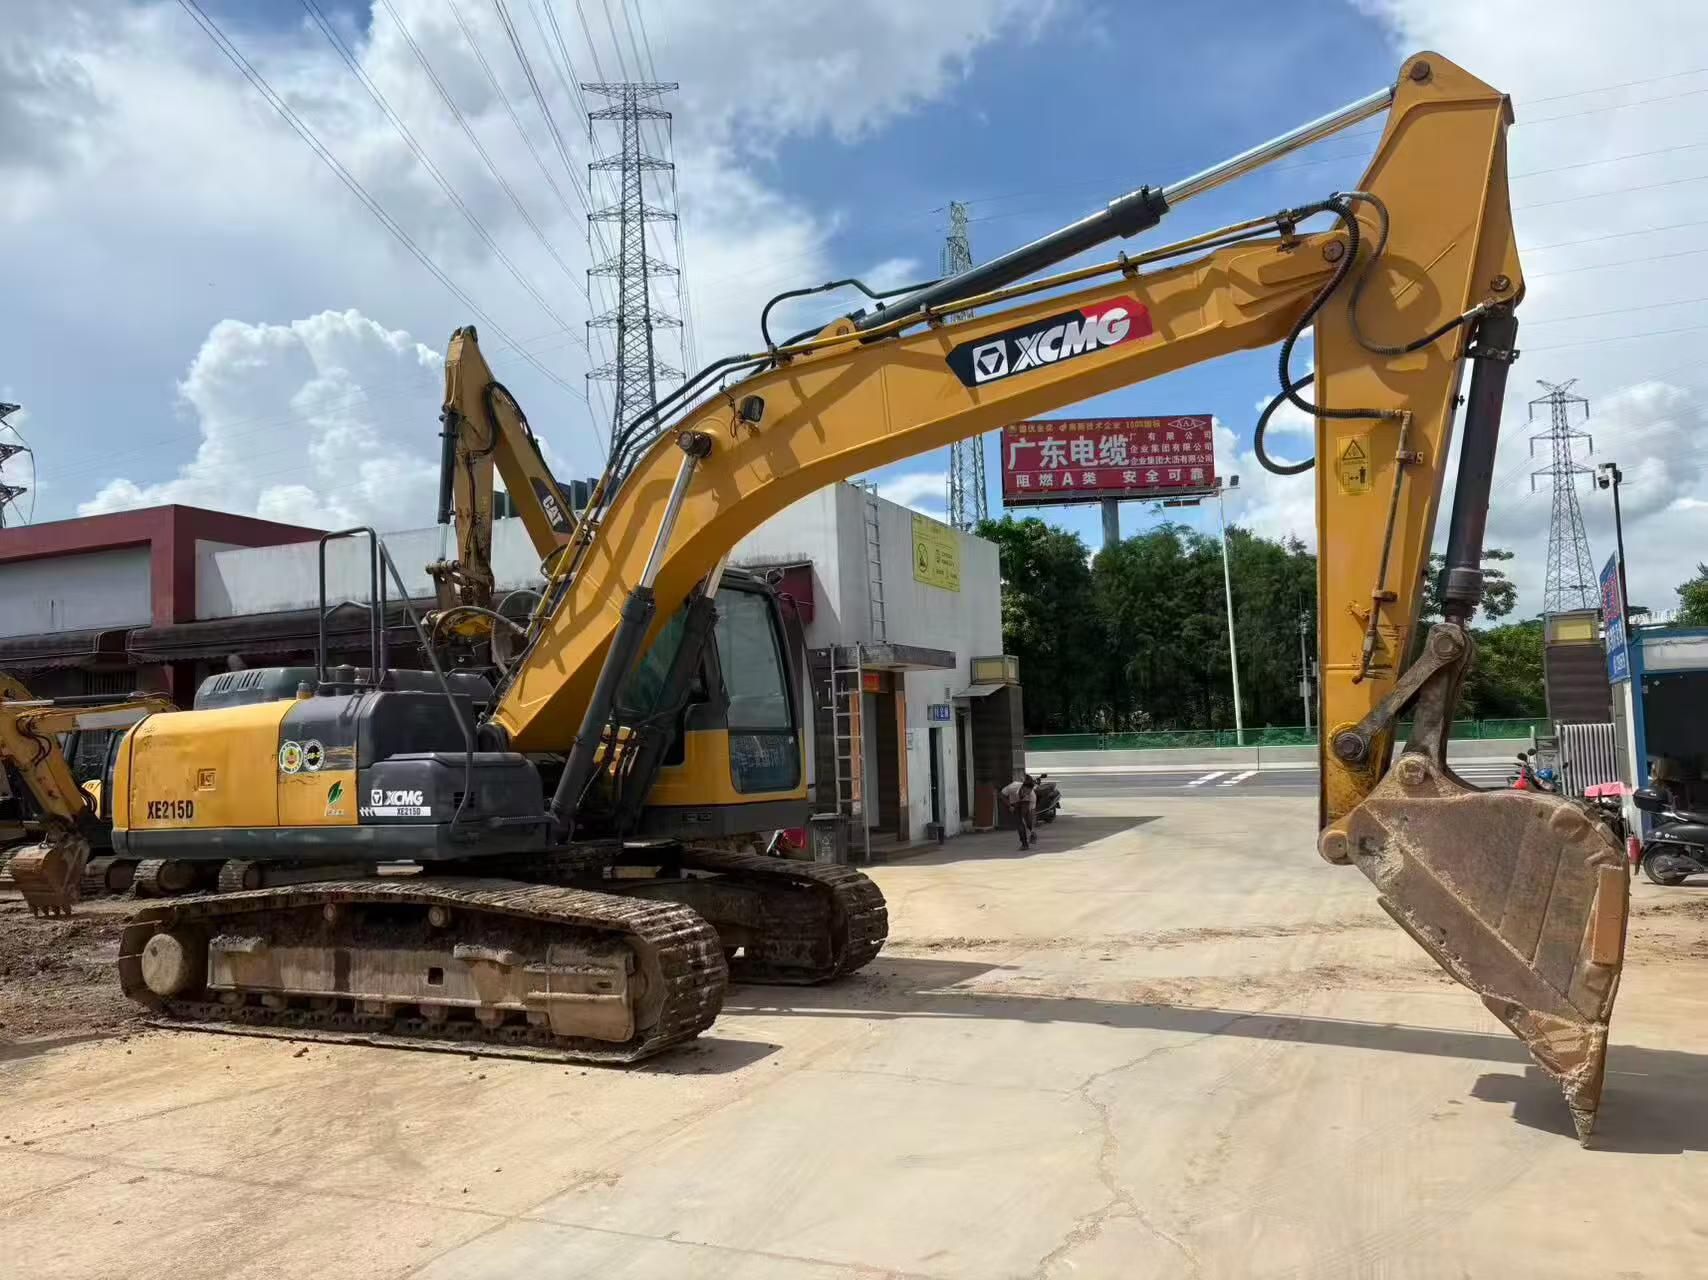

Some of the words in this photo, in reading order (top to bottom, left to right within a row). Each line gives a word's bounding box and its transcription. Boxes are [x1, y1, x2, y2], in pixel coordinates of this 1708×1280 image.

[1010, 307, 1131, 373] XCMG
[1008, 434, 1130, 470] 广东电缆
[1130, 442, 1213, 454] 企业集团有限公司
[1016, 471, 1097, 488] 阻燃A类
[1122, 467, 1204, 484] 安全可靠
[543, 495, 564, 527] CAT
[384, 790, 424, 806] XCMG
[147, 800, 194, 820] XE215D
[396, 807, 421, 816] XE215D
